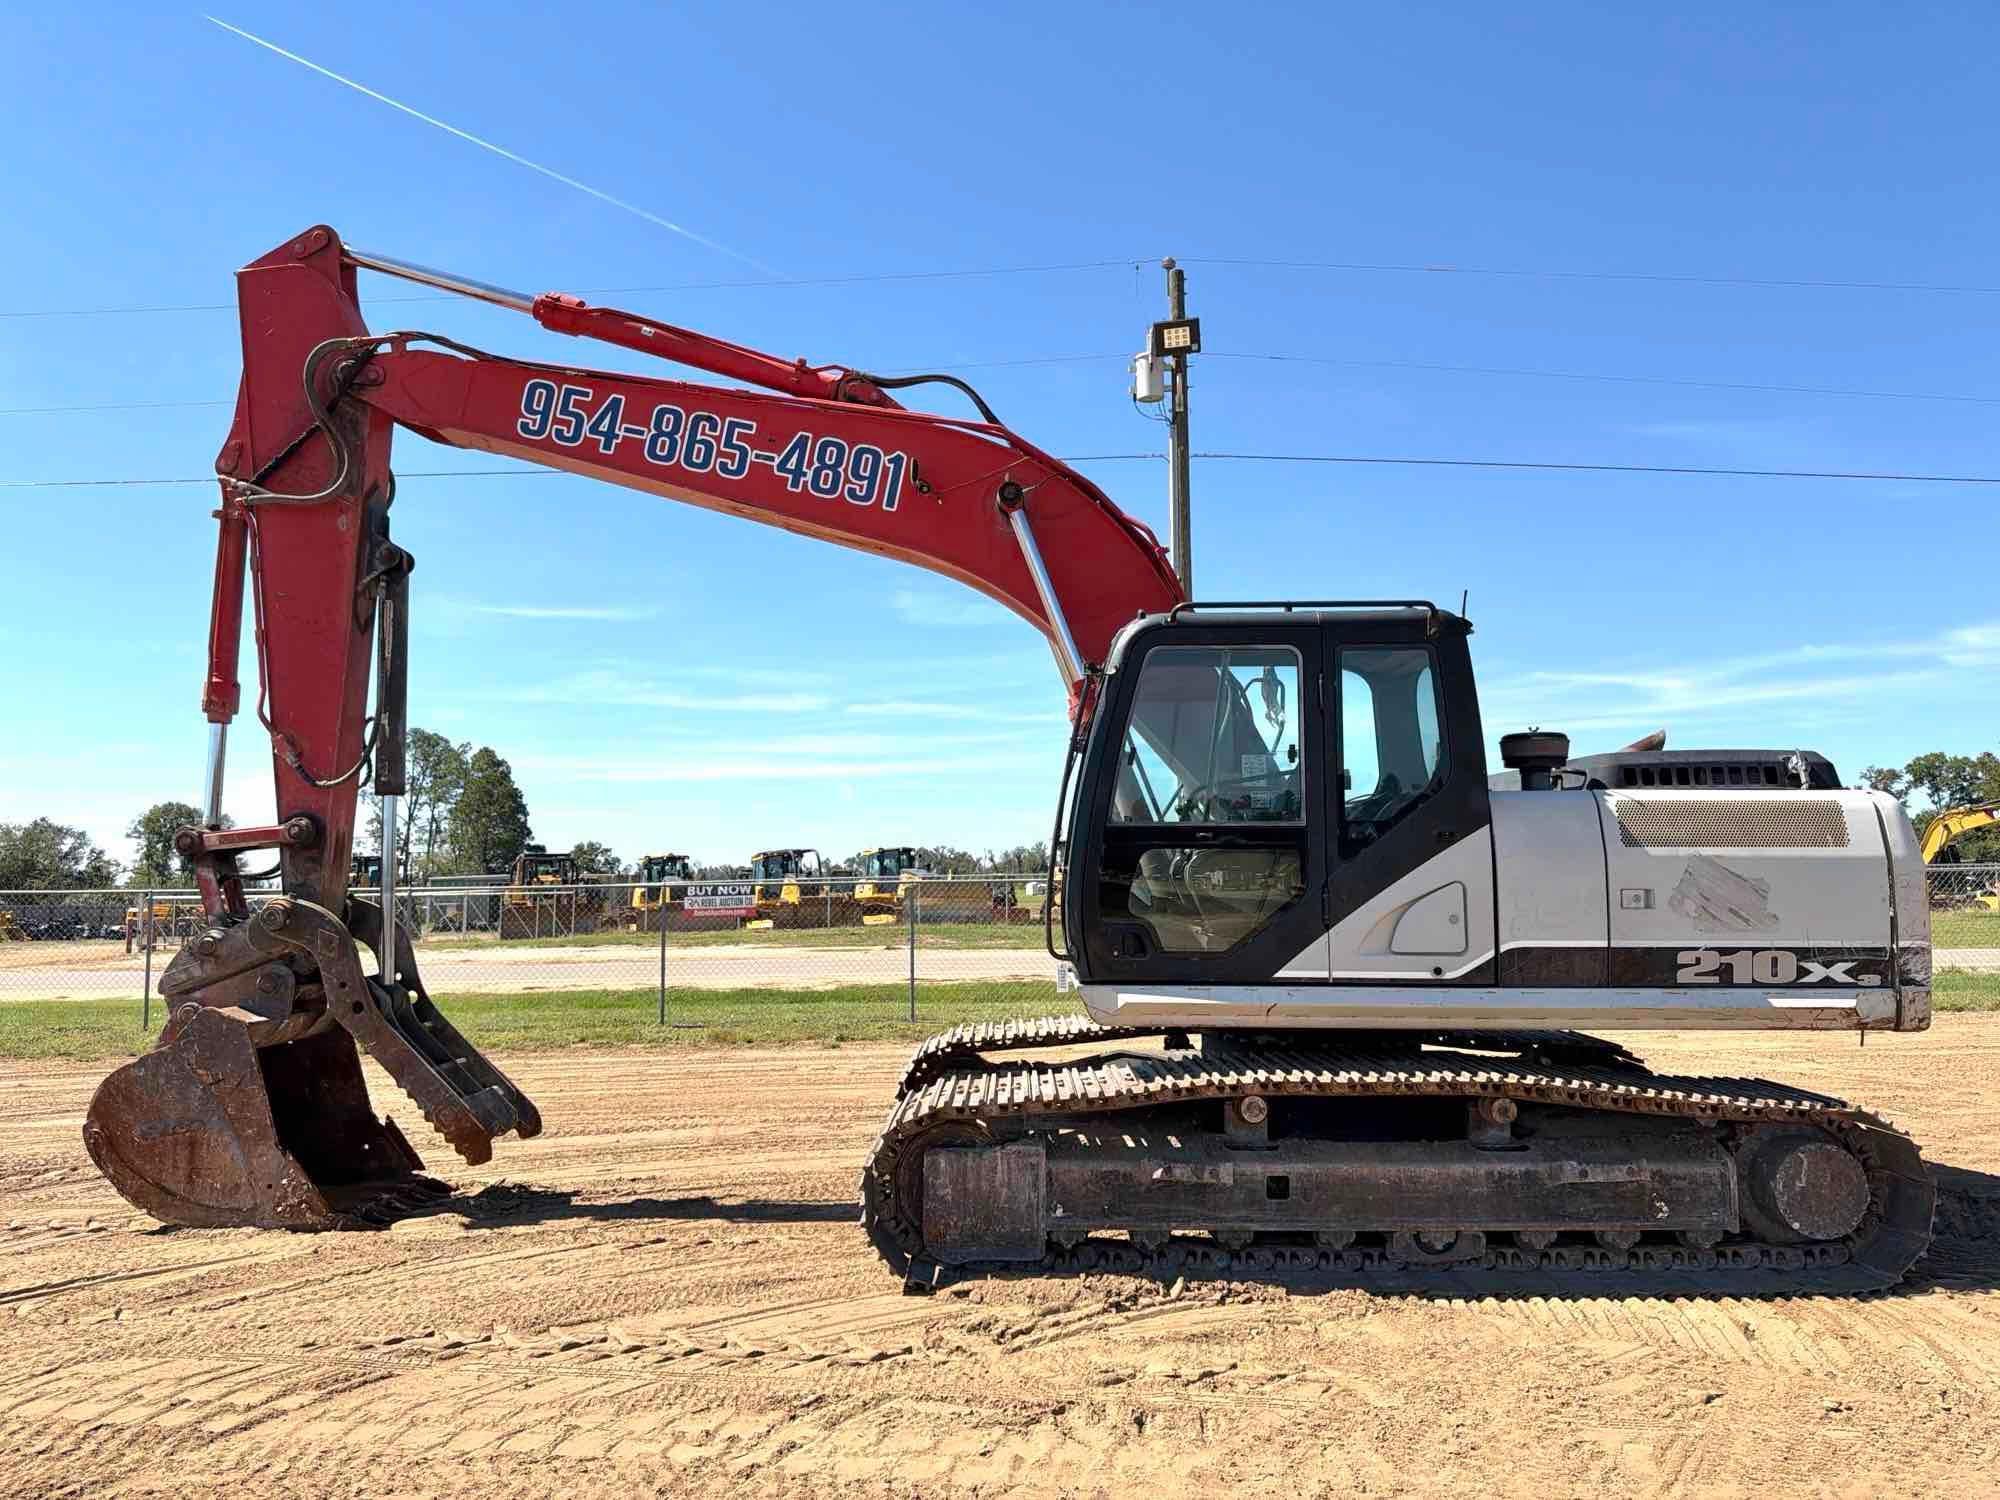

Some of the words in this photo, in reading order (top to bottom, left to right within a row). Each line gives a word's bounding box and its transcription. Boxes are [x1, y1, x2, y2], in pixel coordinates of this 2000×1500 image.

[517, 380, 907, 511] 954-865-4891
[687, 885, 713, 896] BUY
[717, 885, 752, 896] NOW
